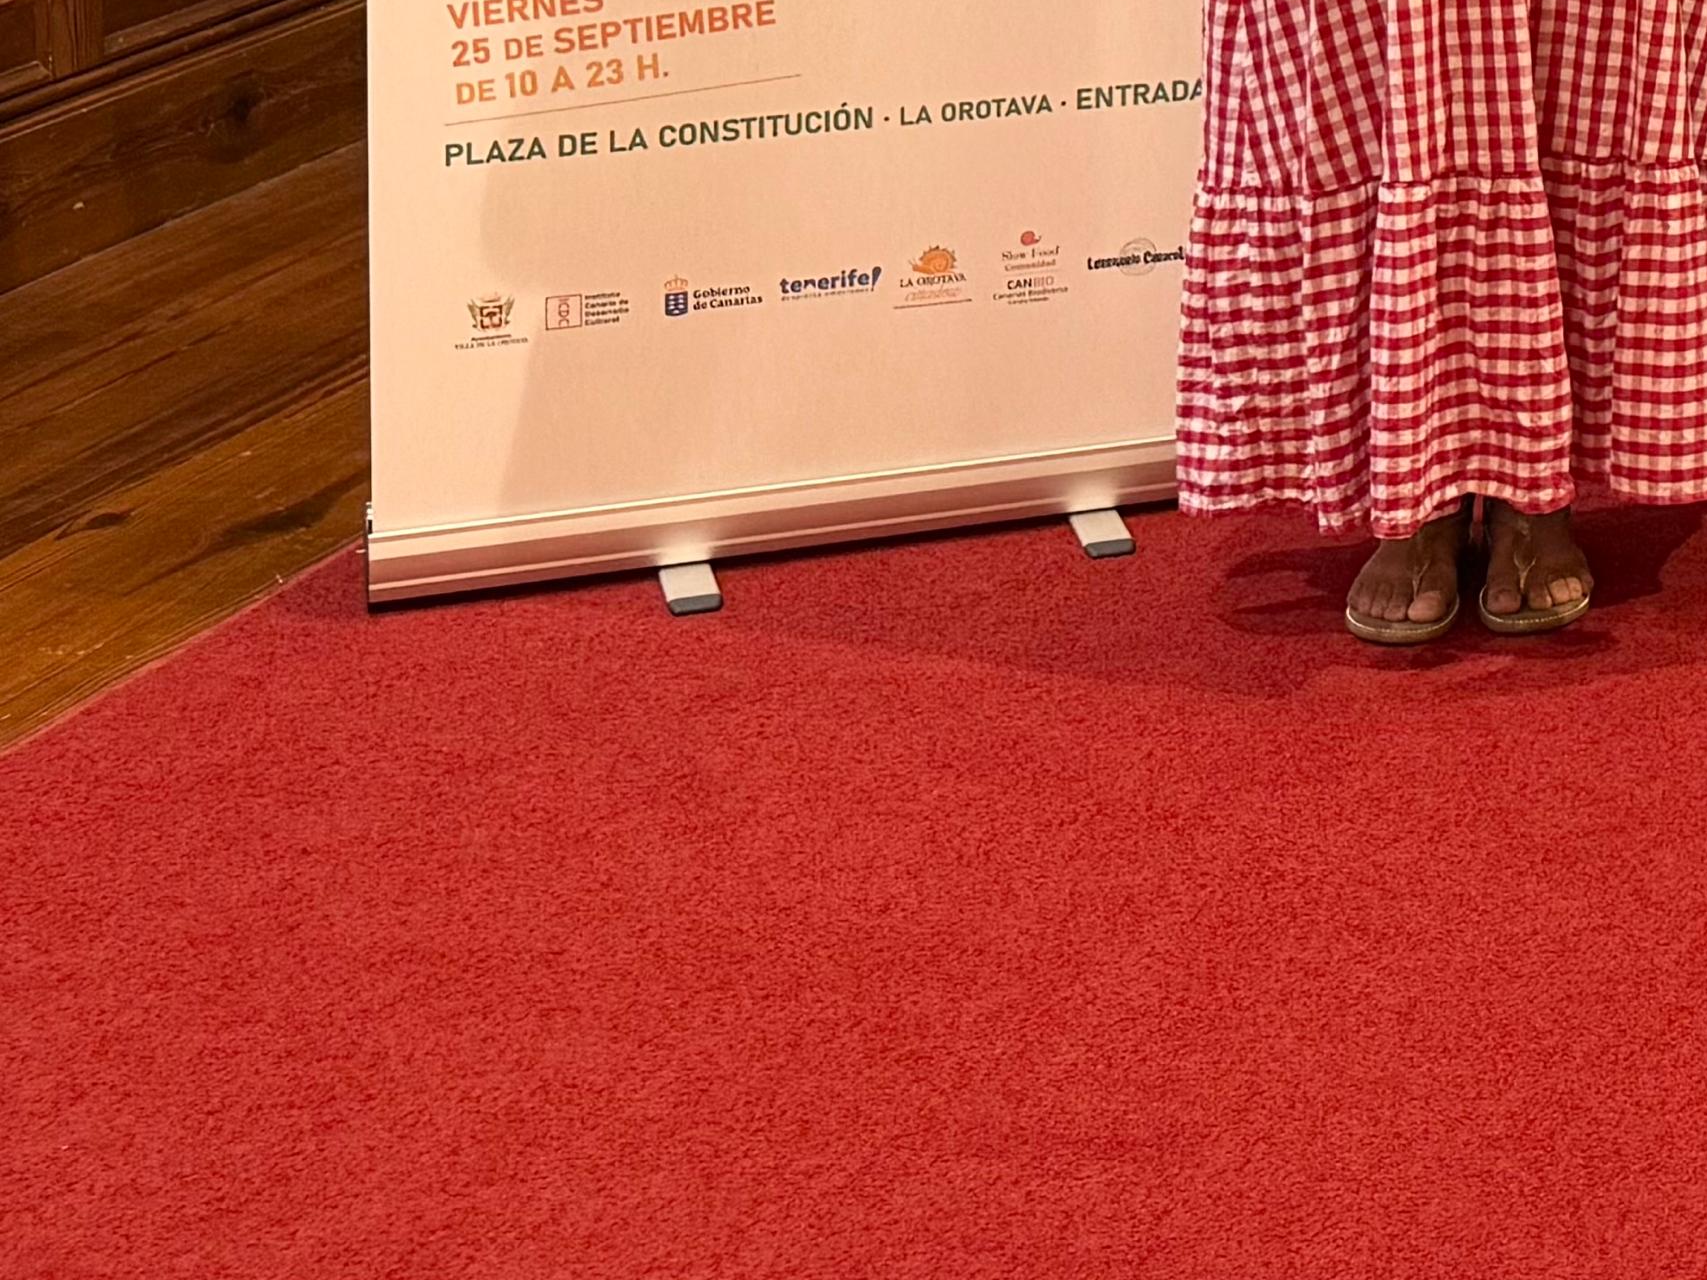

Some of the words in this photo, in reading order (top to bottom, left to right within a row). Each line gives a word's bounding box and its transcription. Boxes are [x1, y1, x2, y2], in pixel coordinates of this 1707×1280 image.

[451, 37, 491, 68] 25
[503, 34, 544, 61] DE
[553, 0, 777, 54] SEPTIEMBRE
[455, 78, 497, 106] DE
[504, 69, 539, 99] 10
[550, 65, 576, 94] A
[585, 58, 624, 89] 23
[636, 52, 669, 81] H.
[445, 136, 547, 167] PLAZA
[558, 131, 598, 158] DE
[609, 127, 649, 153] LA
[659, 104, 873, 148] CONSTITUCIÓN
[900, 105, 933, 126] LA
[941, 94, 1053, 122] OROTAVA
[692, 300, 708, 311] de
[709, 295, 763, 309] Canarias
[693, 286, 751, 304] Gobierno
